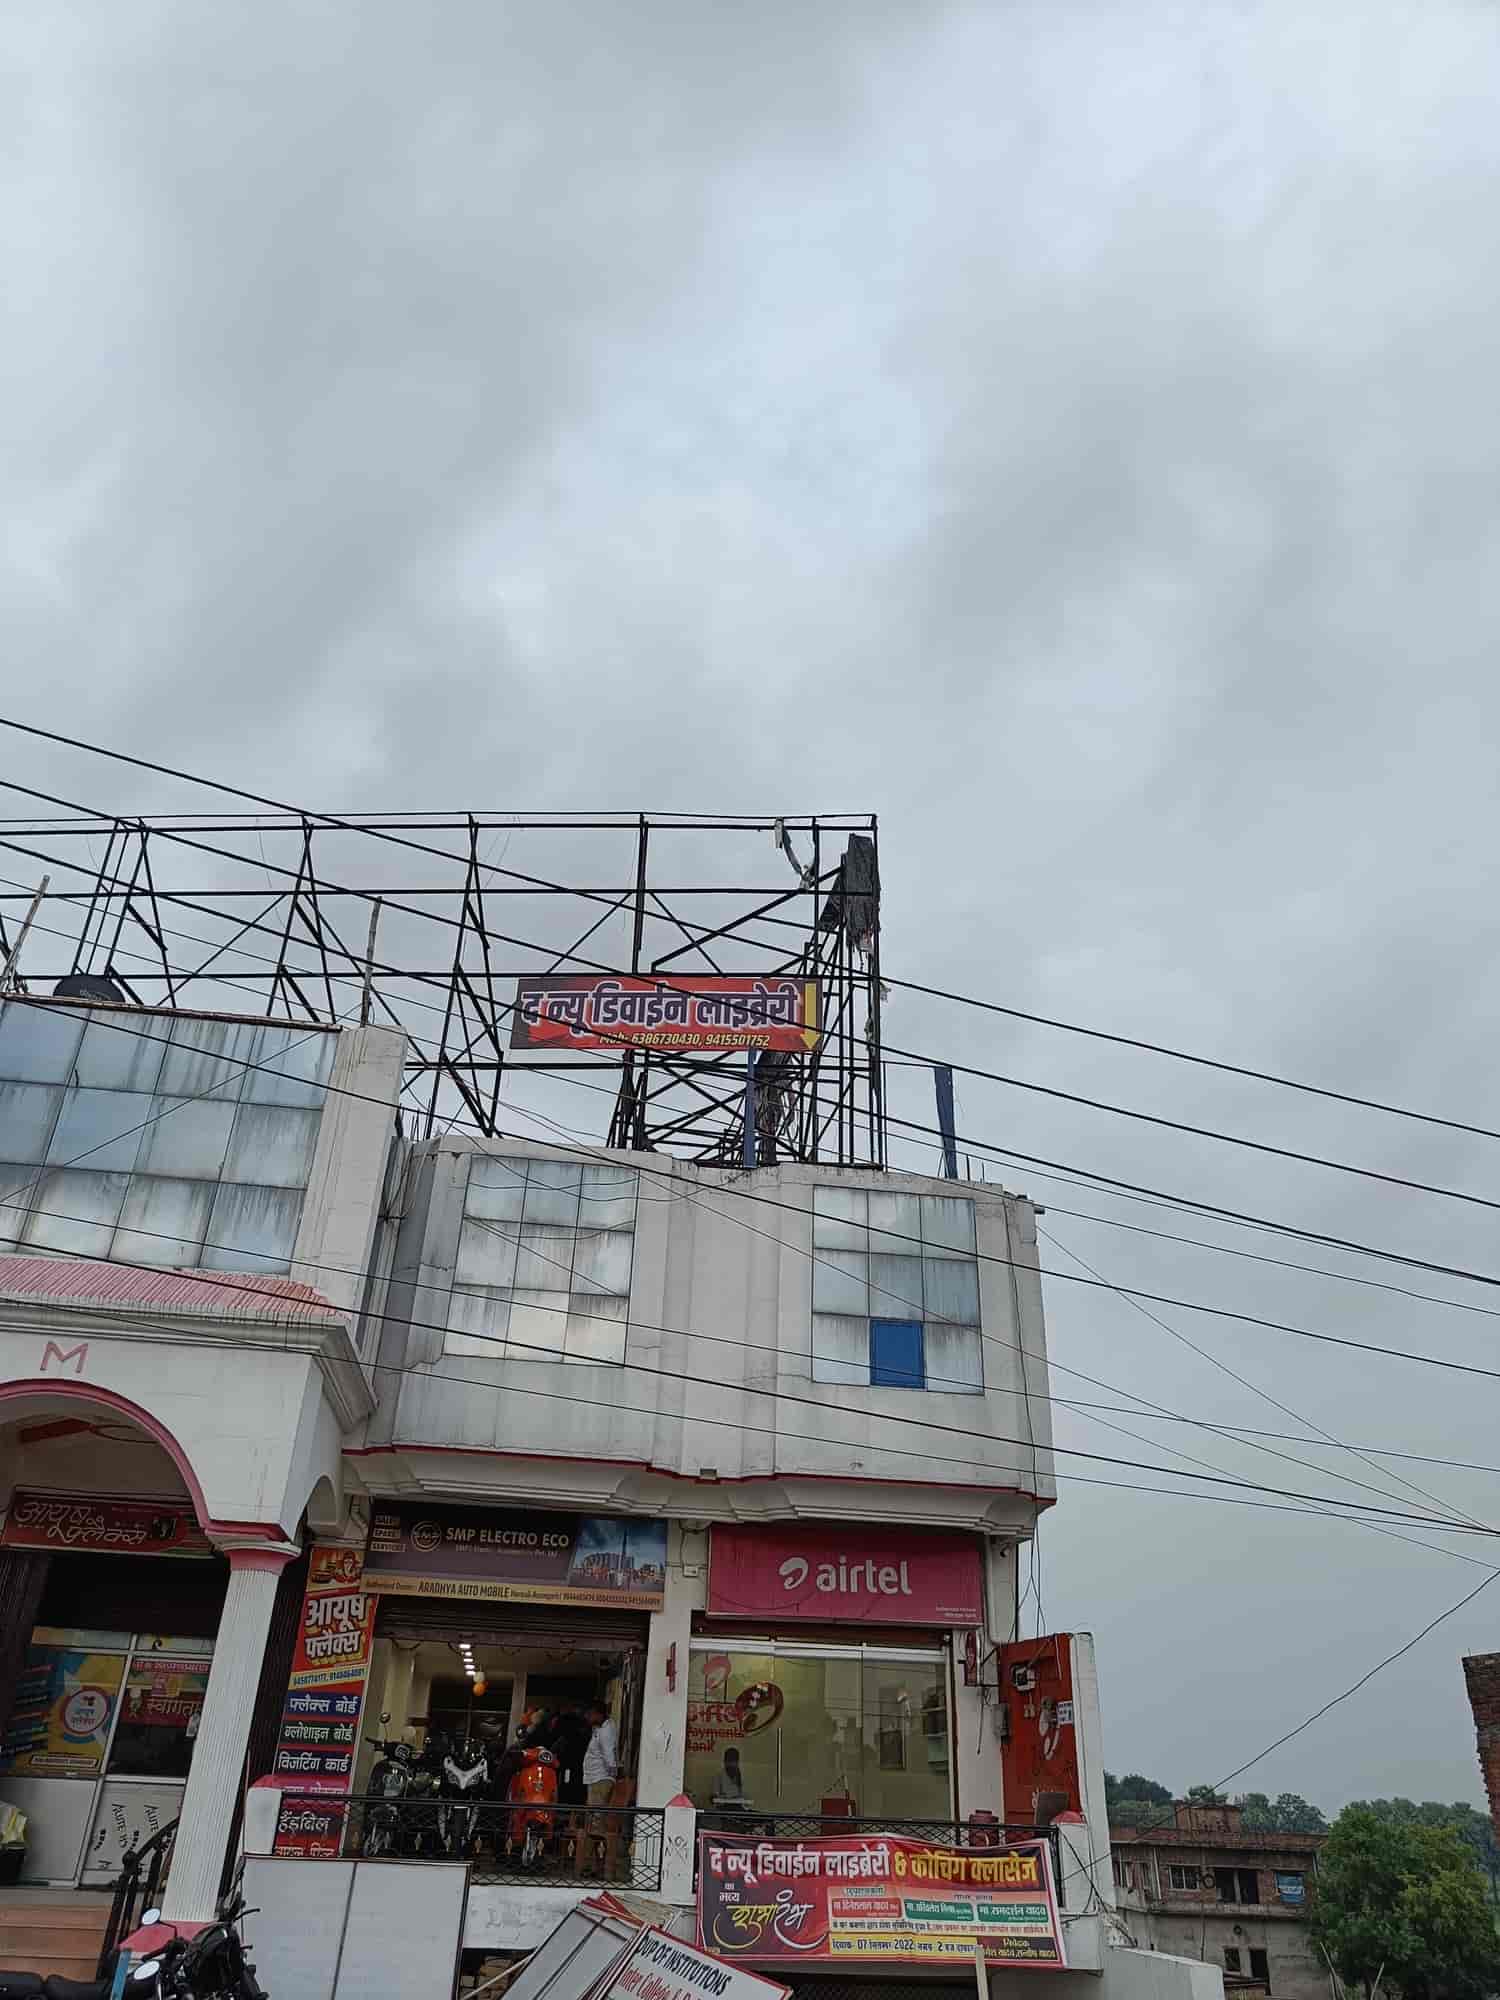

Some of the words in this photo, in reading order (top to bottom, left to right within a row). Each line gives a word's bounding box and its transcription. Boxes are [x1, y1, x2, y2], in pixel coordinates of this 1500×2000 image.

[521, 992, 543, 1025] द
[40, 1341, 88, 1373] M
[446, 1527, 477, 1543] SMP
[480, 1529, 537, 1545] ELECTRO
[542, 1534, 569, 1547] ECO
[459, 1582, 478, 1596] AUTO
[480, 1584, 511, 1598] MOBILE
[816, 1555, 913, 1595] airtel
[708, 1847, 724, 1873] द
[725, 1848, 757, 1884] न्यू
[823, 1844, 890, 1879] लाइब्रेरी
[894, 1939, 913, 1951] 2022
[652, 1943, 673, 1966] OF
[663, 1950, 732, 1997] INSTITUTIONS
